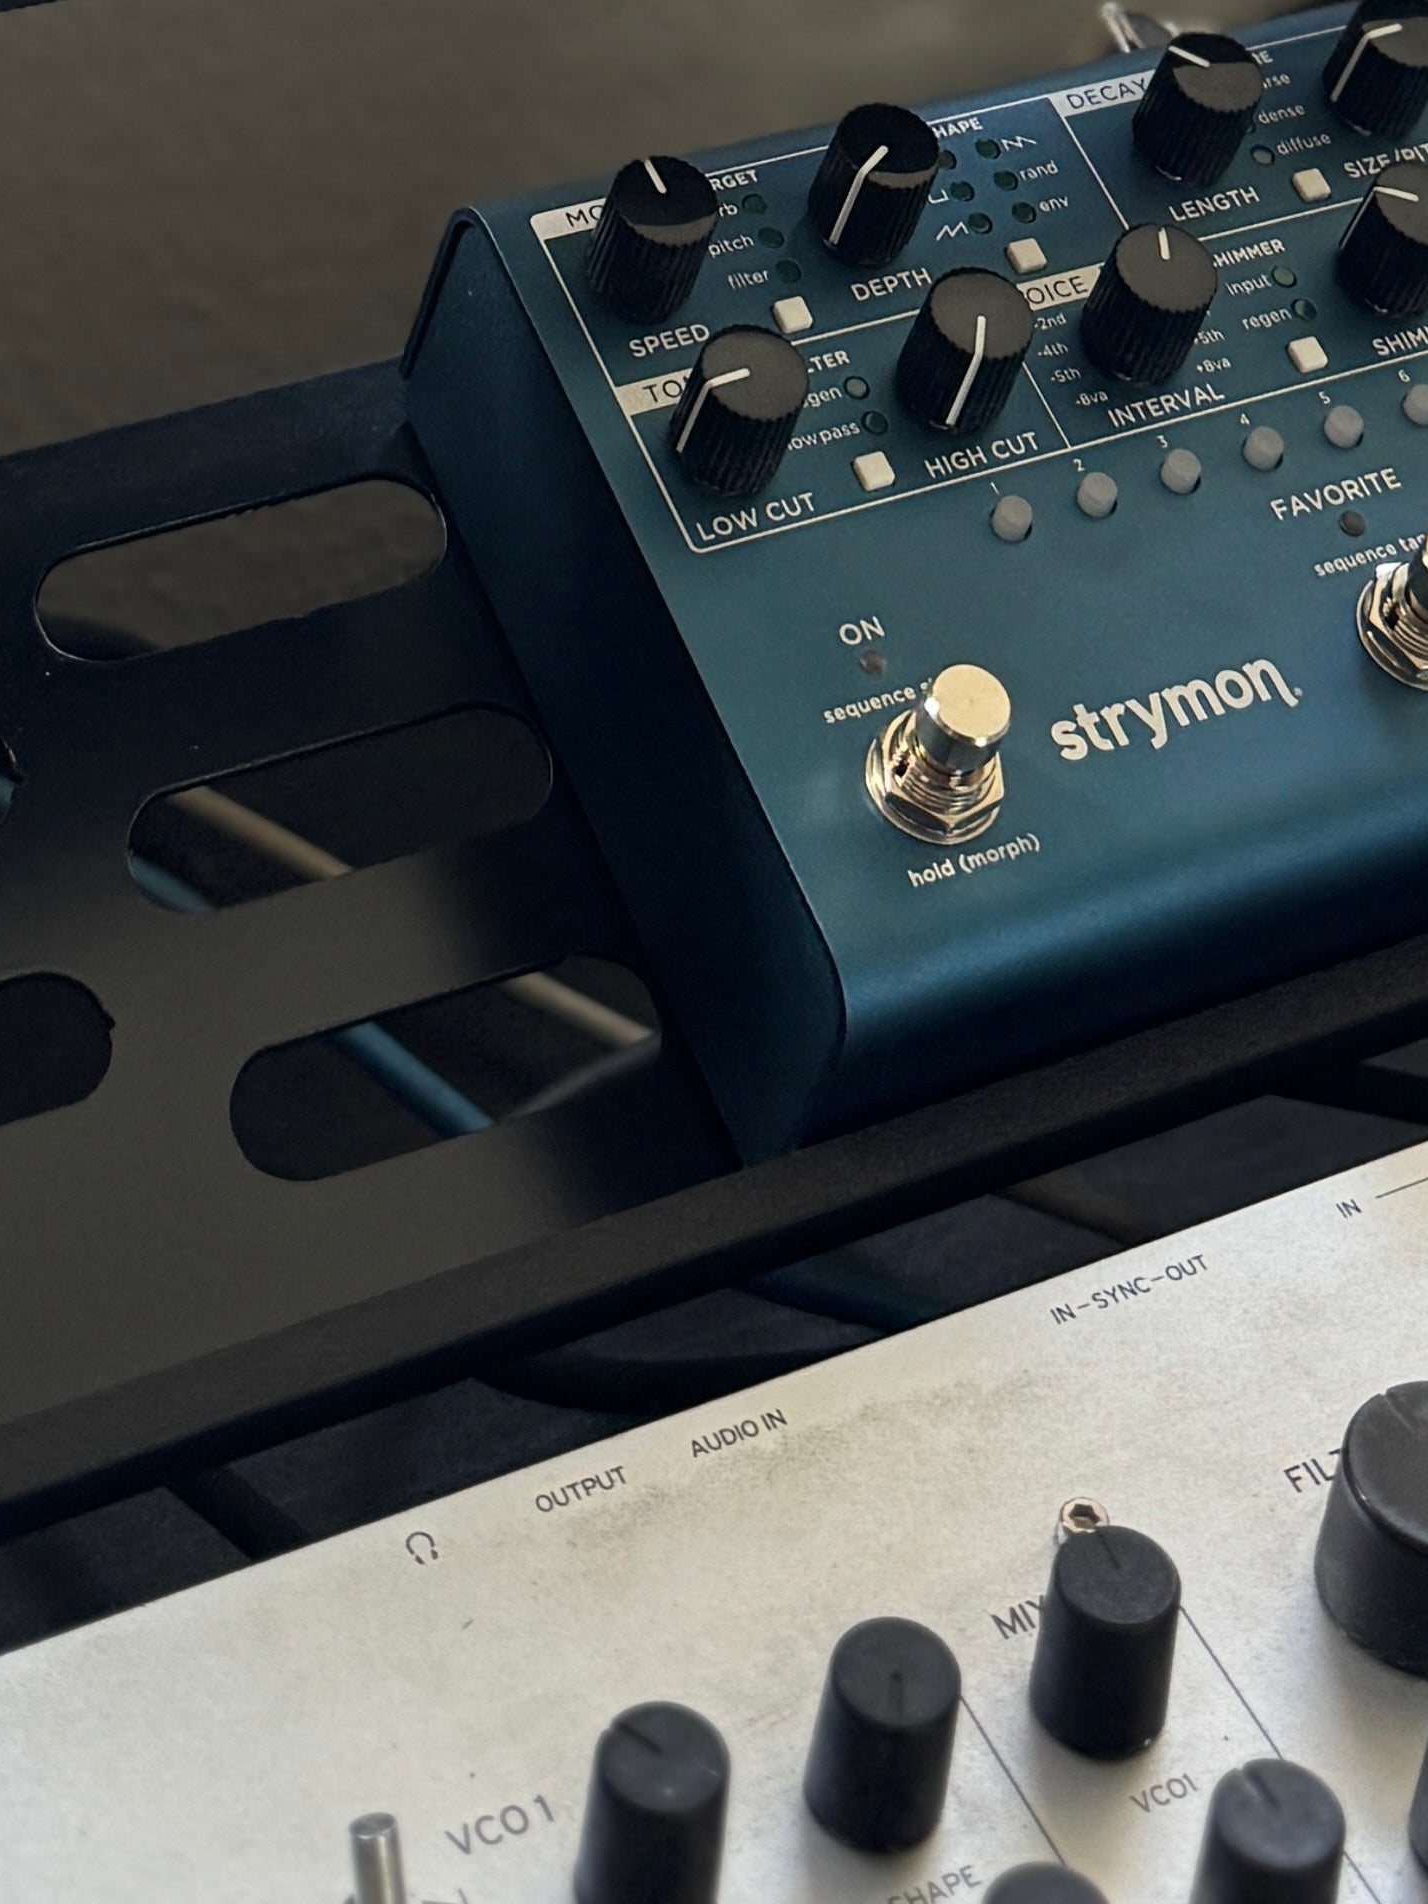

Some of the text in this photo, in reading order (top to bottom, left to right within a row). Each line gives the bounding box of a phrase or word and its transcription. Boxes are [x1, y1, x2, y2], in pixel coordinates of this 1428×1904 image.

[1066, 79, 1146, 109] DECAY
[1258, 104, 1305, 124] dense
[1276, 134, 1332, 155] diffuse
[1019, 160, 1059, 181] rand
[1039, 196, 1069, 212] env
[1169, 187, 1260, 222] LENGTH
[707, 234, 756, 258] pitch
[727, 270, 769, 290] filter
[851, 268, 933, 302] DEPTH
[1225, 272, 1272, 297] input
[1242, 305, 1292, 330] regen
[629, 324, 710, 359] SPEED
[1108, 384, 1225, 428] INTERVAL
[924, 432, 1039, 479] HIGH CUT
[1269, 467, 1402, 521] FAVORITE
[696, 492, 817, 542] LOW CUT
[1314, 543, 1397, 577] sequence
[839, 616, 886, 646] ON
[823, 686, 917, 724] sequence
[1051, 656, 1298, 761] strymon
[907, 832, 1041, 887] hold (morph)
[1336, 1198, 1363, 1219] IN
[689, 1408, 789, 1458] AUDIO IN
[534, 1465, 629, 1514] OUTPUT
[444, 1804, 530, 1856] VCO
